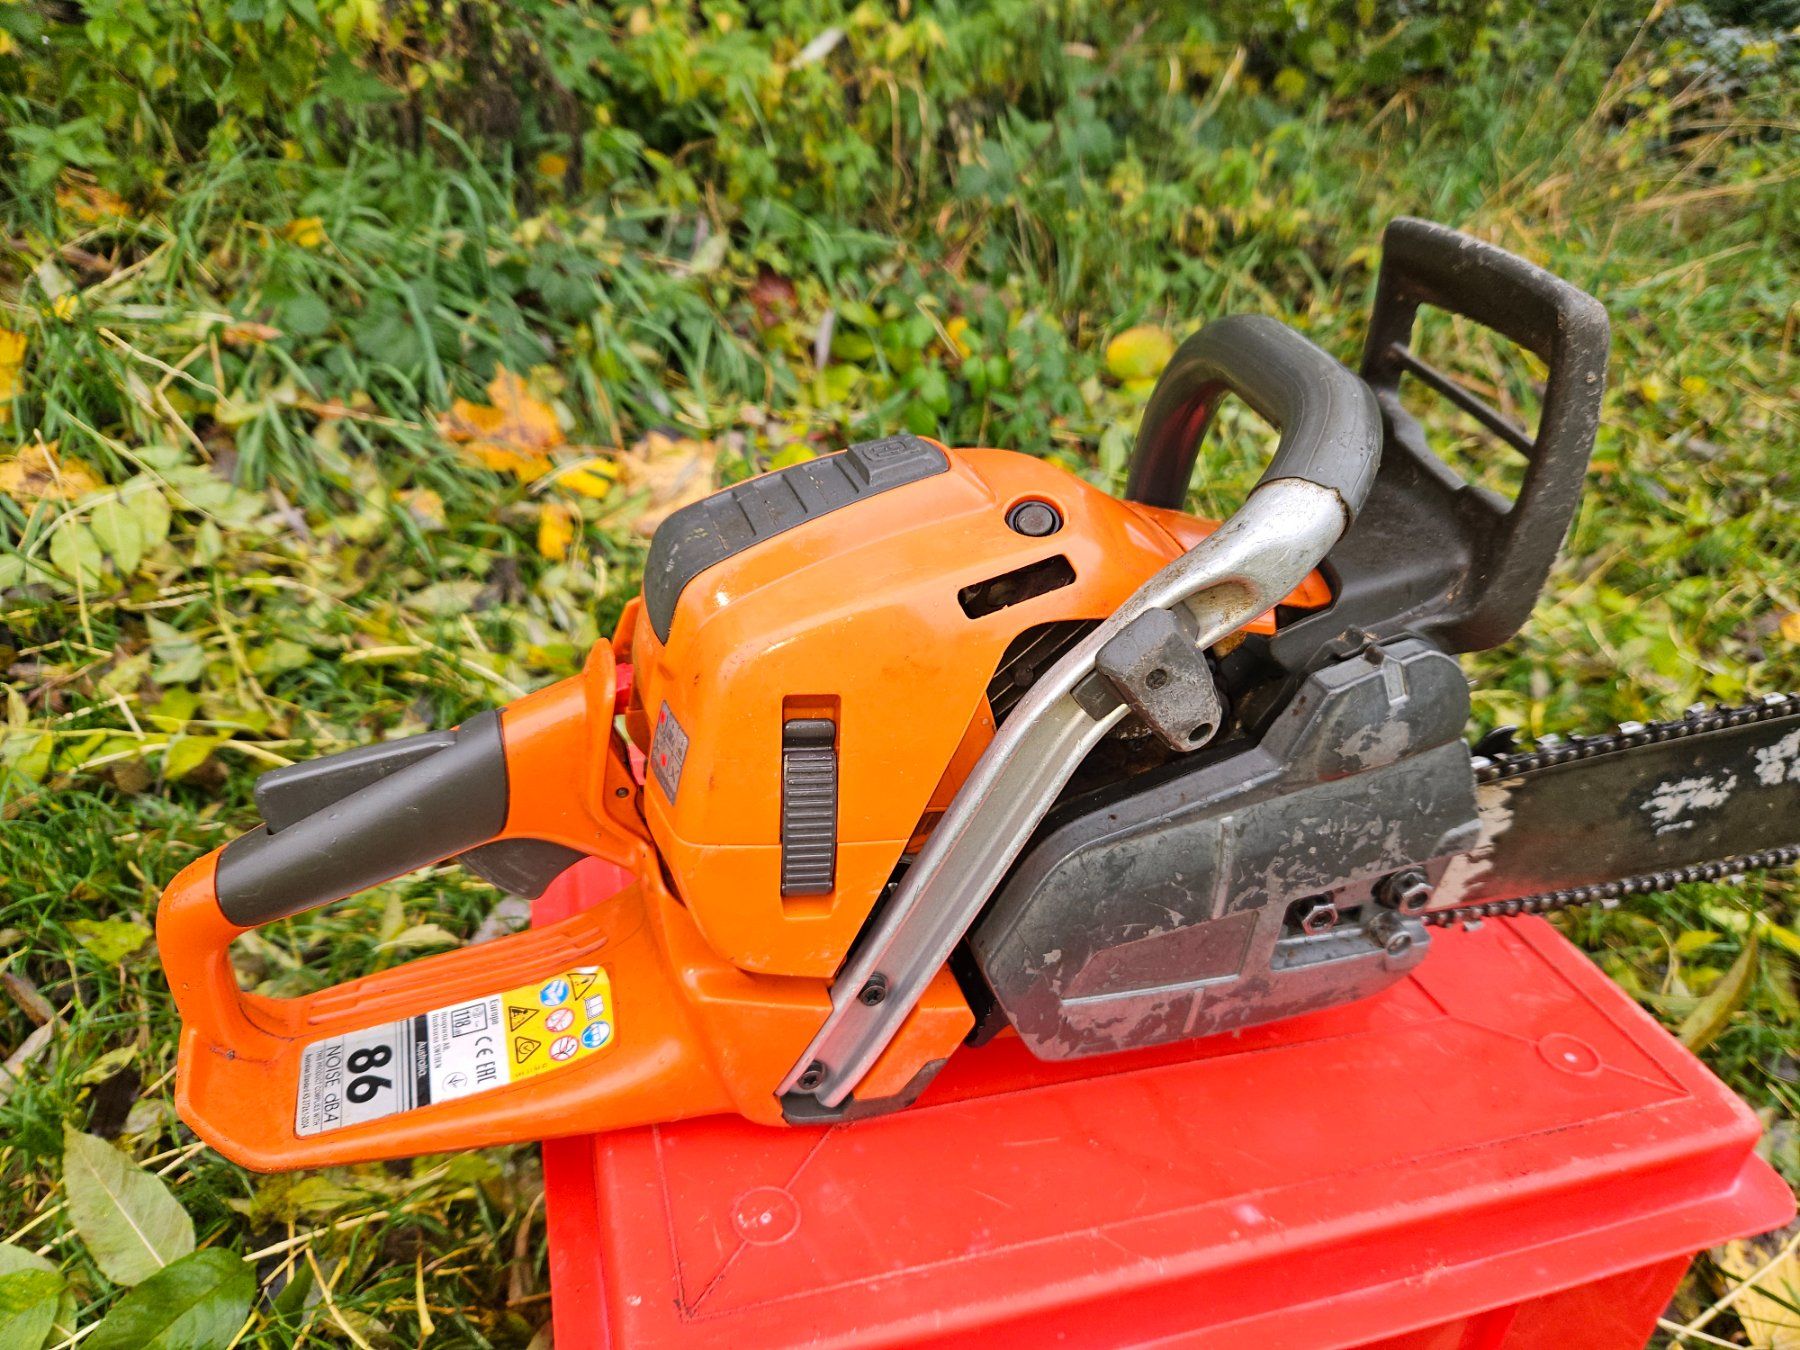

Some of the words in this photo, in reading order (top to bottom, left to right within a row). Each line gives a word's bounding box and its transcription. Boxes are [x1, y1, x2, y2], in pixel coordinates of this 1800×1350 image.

[454, 1010, 471, 1028] 118
[475, 1036, 493, 1058] CE
[325, 1045, 342, 1087] NOISE
[346, 1044, 392, 1104] 86
